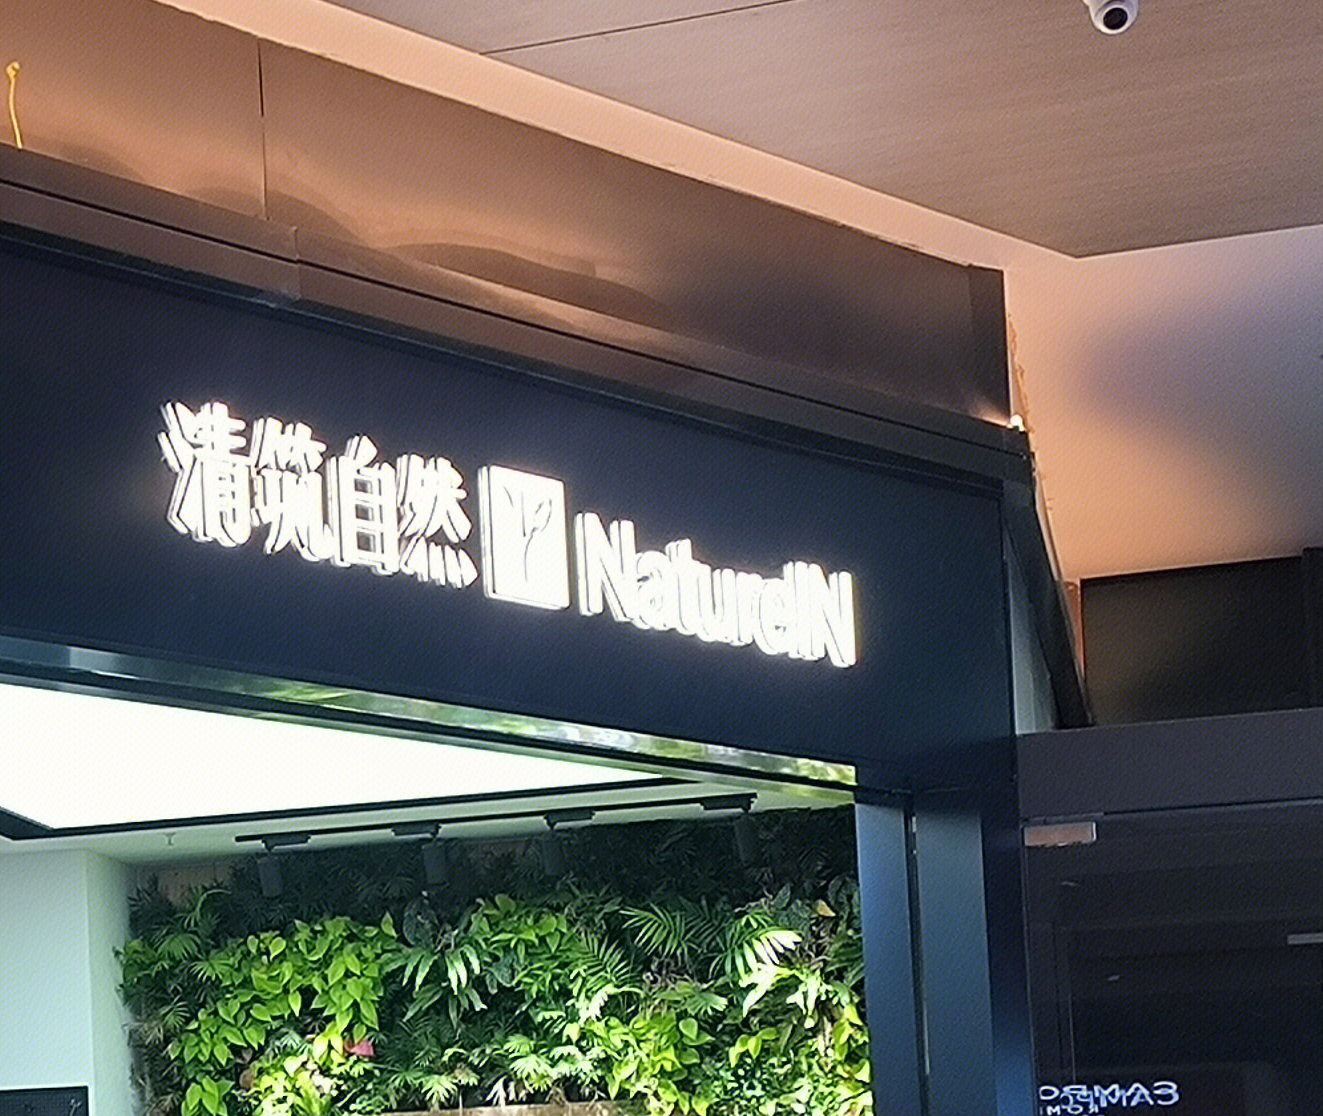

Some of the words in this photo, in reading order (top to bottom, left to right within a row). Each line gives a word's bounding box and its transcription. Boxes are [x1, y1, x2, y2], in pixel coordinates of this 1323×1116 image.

[158, 400, 479, 589] 清筑自然
[575, 510, 856, 668] NatureIN
